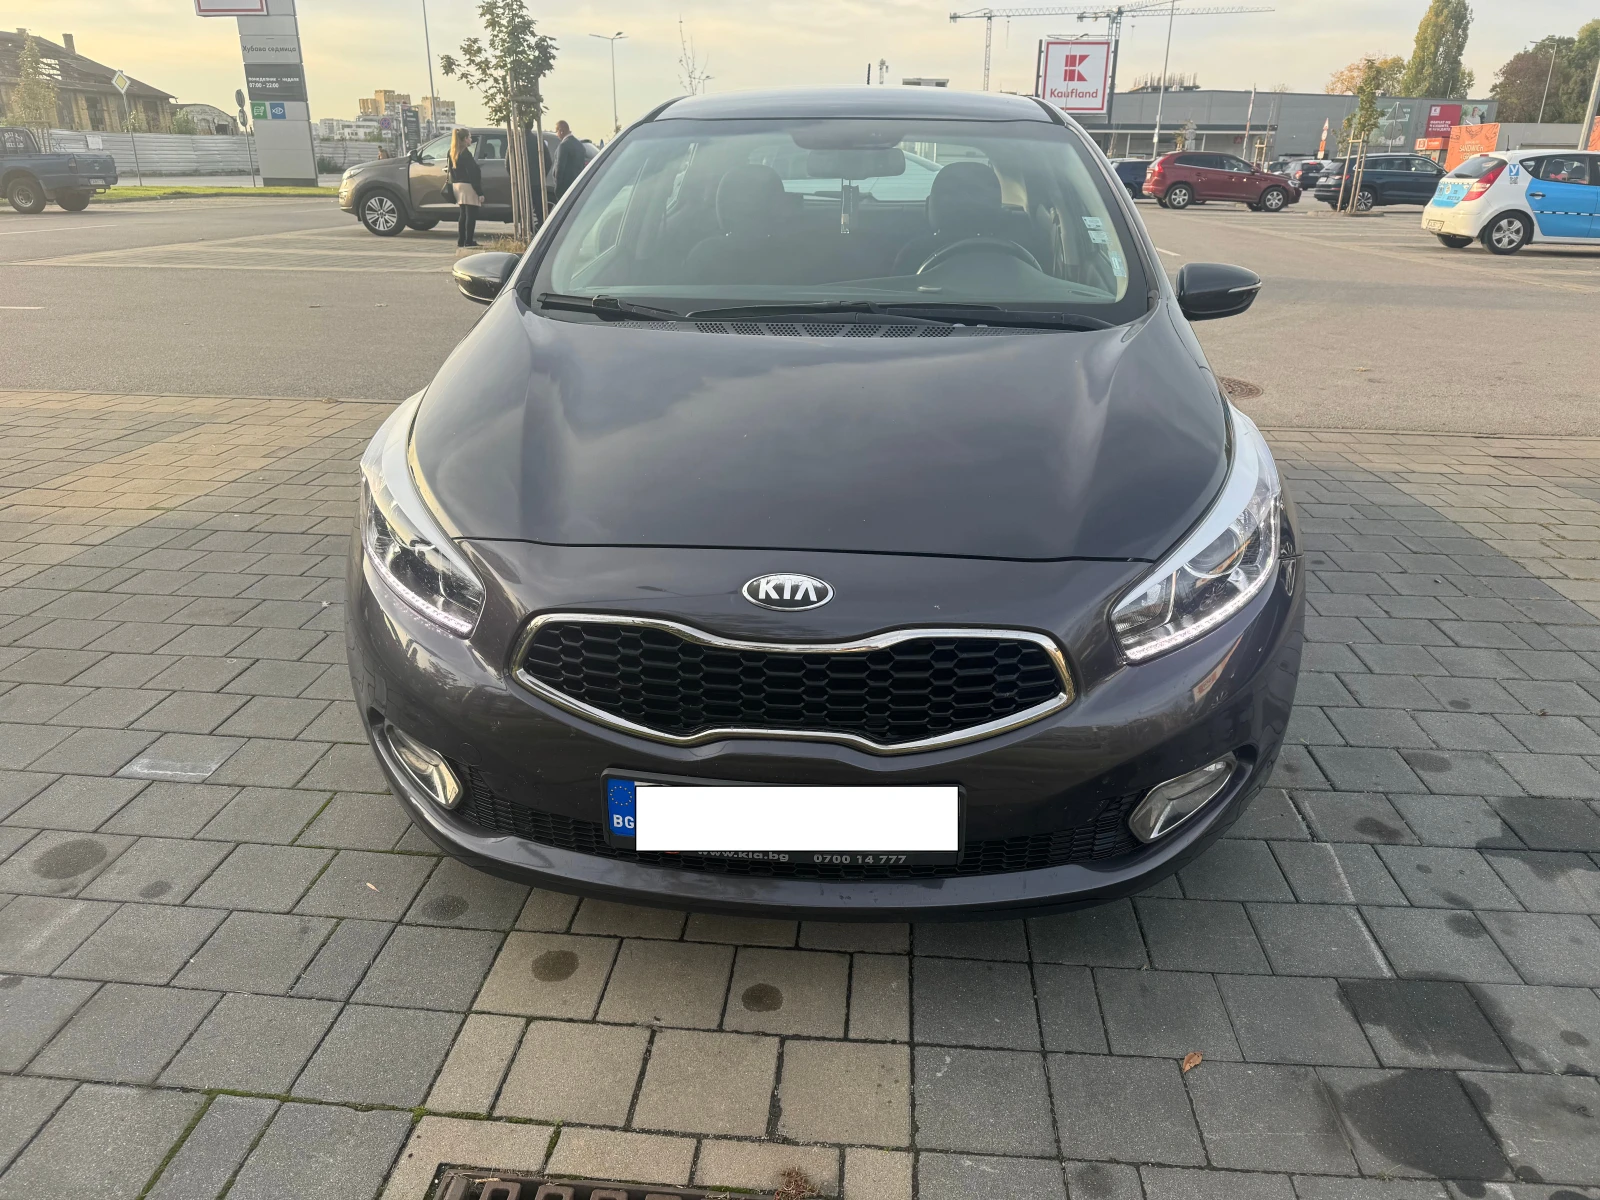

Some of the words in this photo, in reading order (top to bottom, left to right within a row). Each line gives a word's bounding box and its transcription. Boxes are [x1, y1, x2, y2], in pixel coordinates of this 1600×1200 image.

[1050, 88, 1098, 98] Kaufland
[758, 578, 818, 602] KIA
[613, 813, 635, 829] BG
[813, 853, 851, 864] 0700
[856, 854, 874, 864] 14
[878, 854, 907, 864] 777
